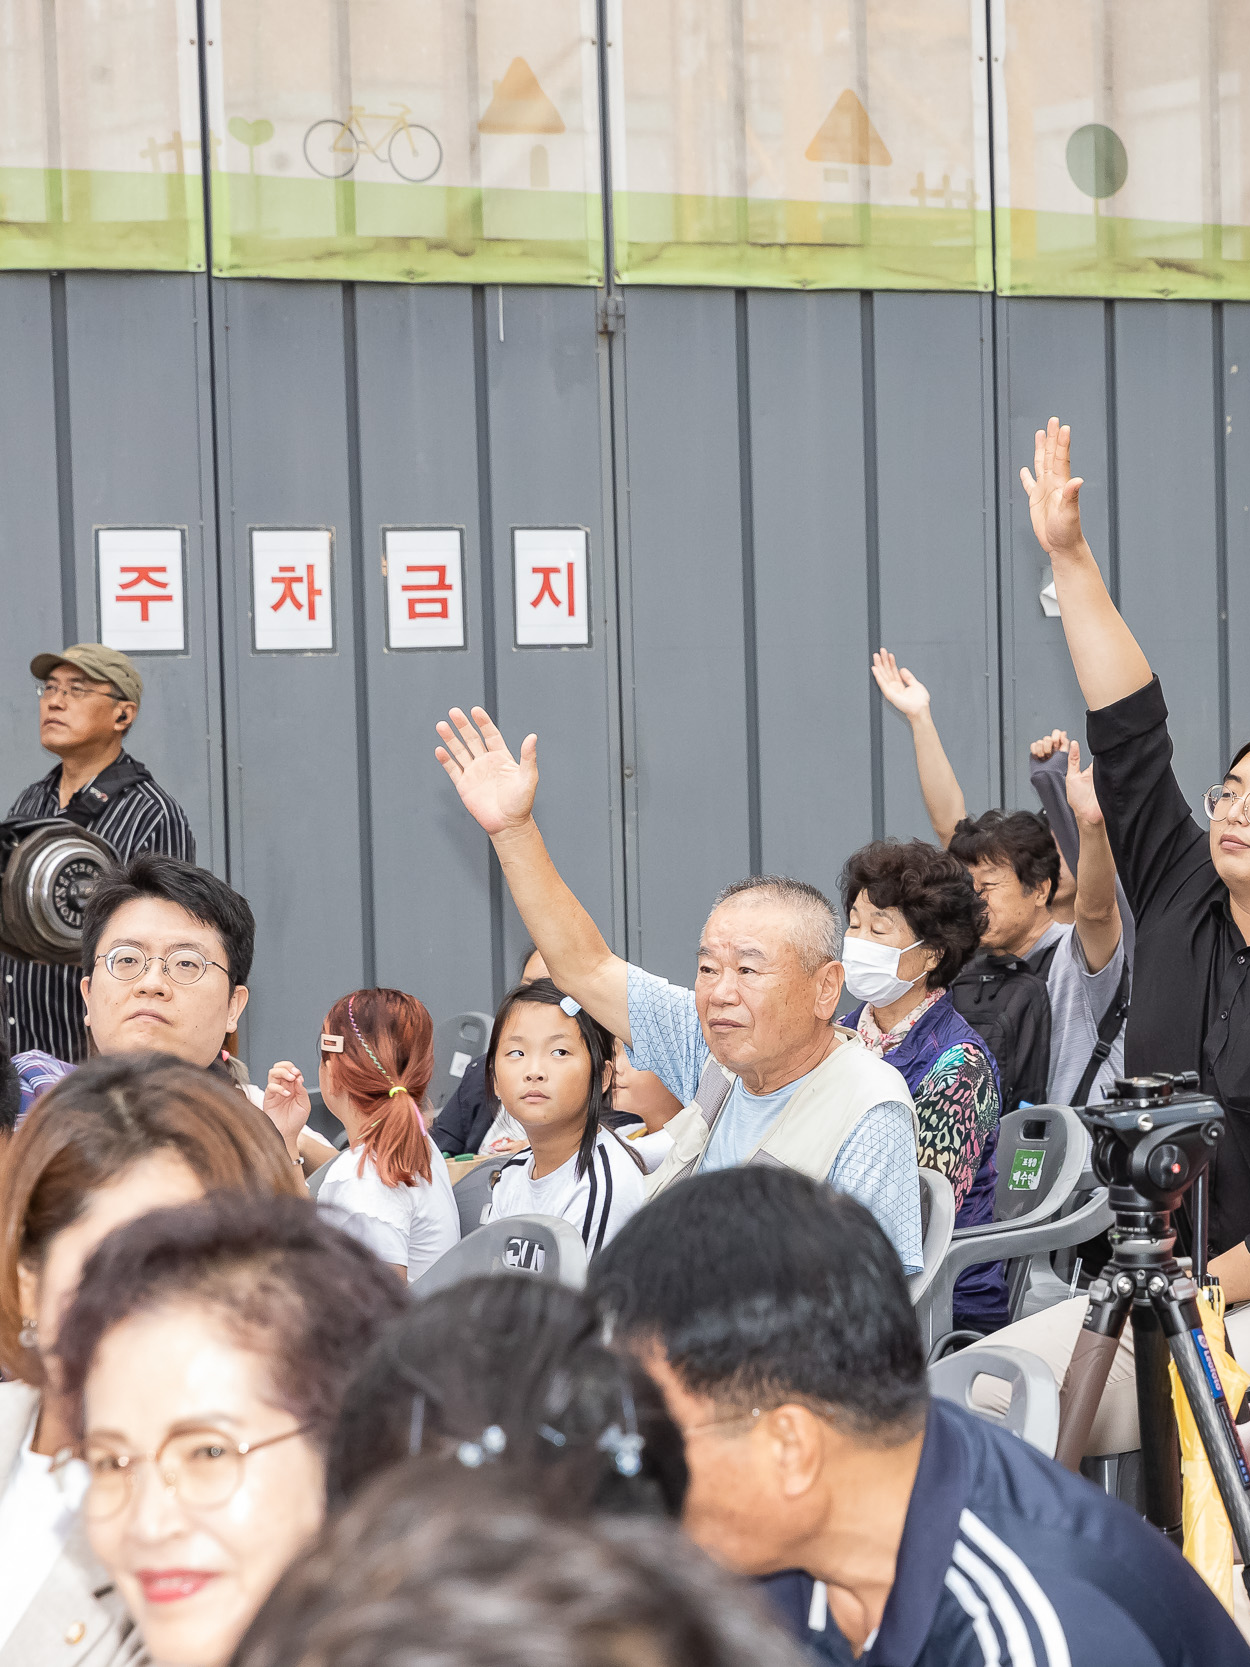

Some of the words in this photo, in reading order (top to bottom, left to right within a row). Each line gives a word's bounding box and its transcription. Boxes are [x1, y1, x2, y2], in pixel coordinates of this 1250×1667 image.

[115, 566, 173, 622] 주
[270, 564, 322, 621] 차
[401, 564, 453, 620] 금
[530, 562, 575, 617] 지
